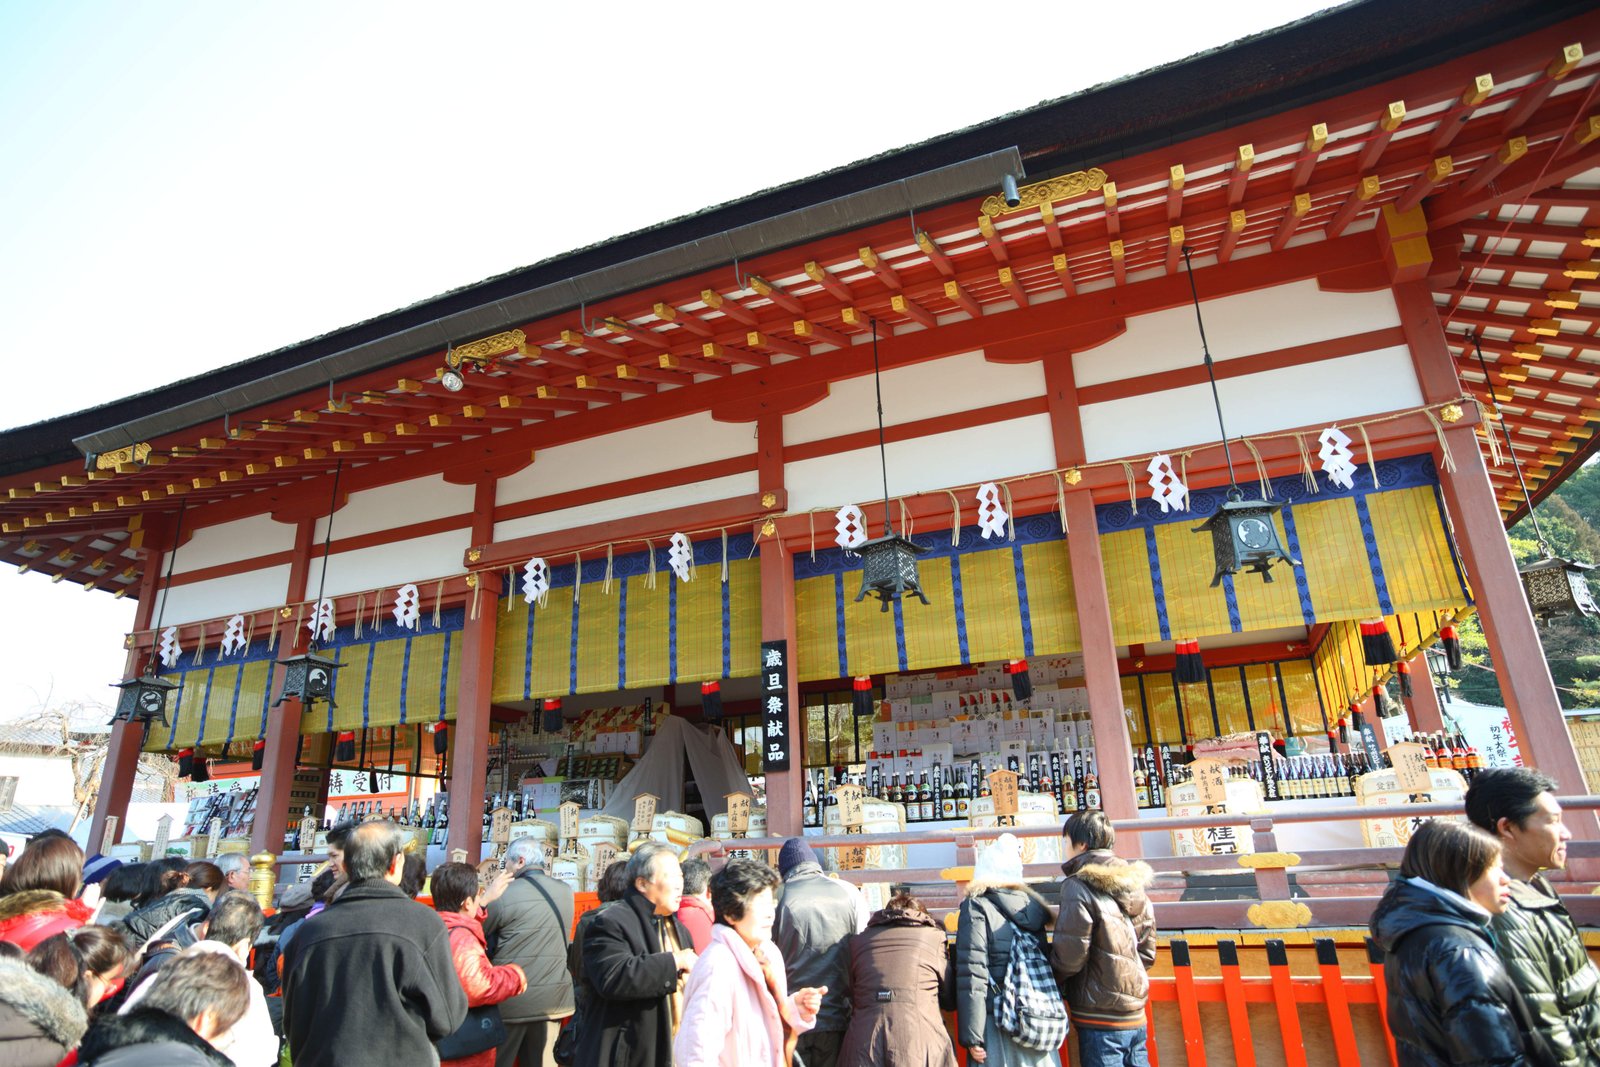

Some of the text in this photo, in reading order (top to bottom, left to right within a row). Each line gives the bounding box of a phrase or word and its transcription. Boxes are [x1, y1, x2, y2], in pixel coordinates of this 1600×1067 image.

[765, 649, 785, 762] 歳旦祭献品
[1209, 764, 1223, 786] 献酒
